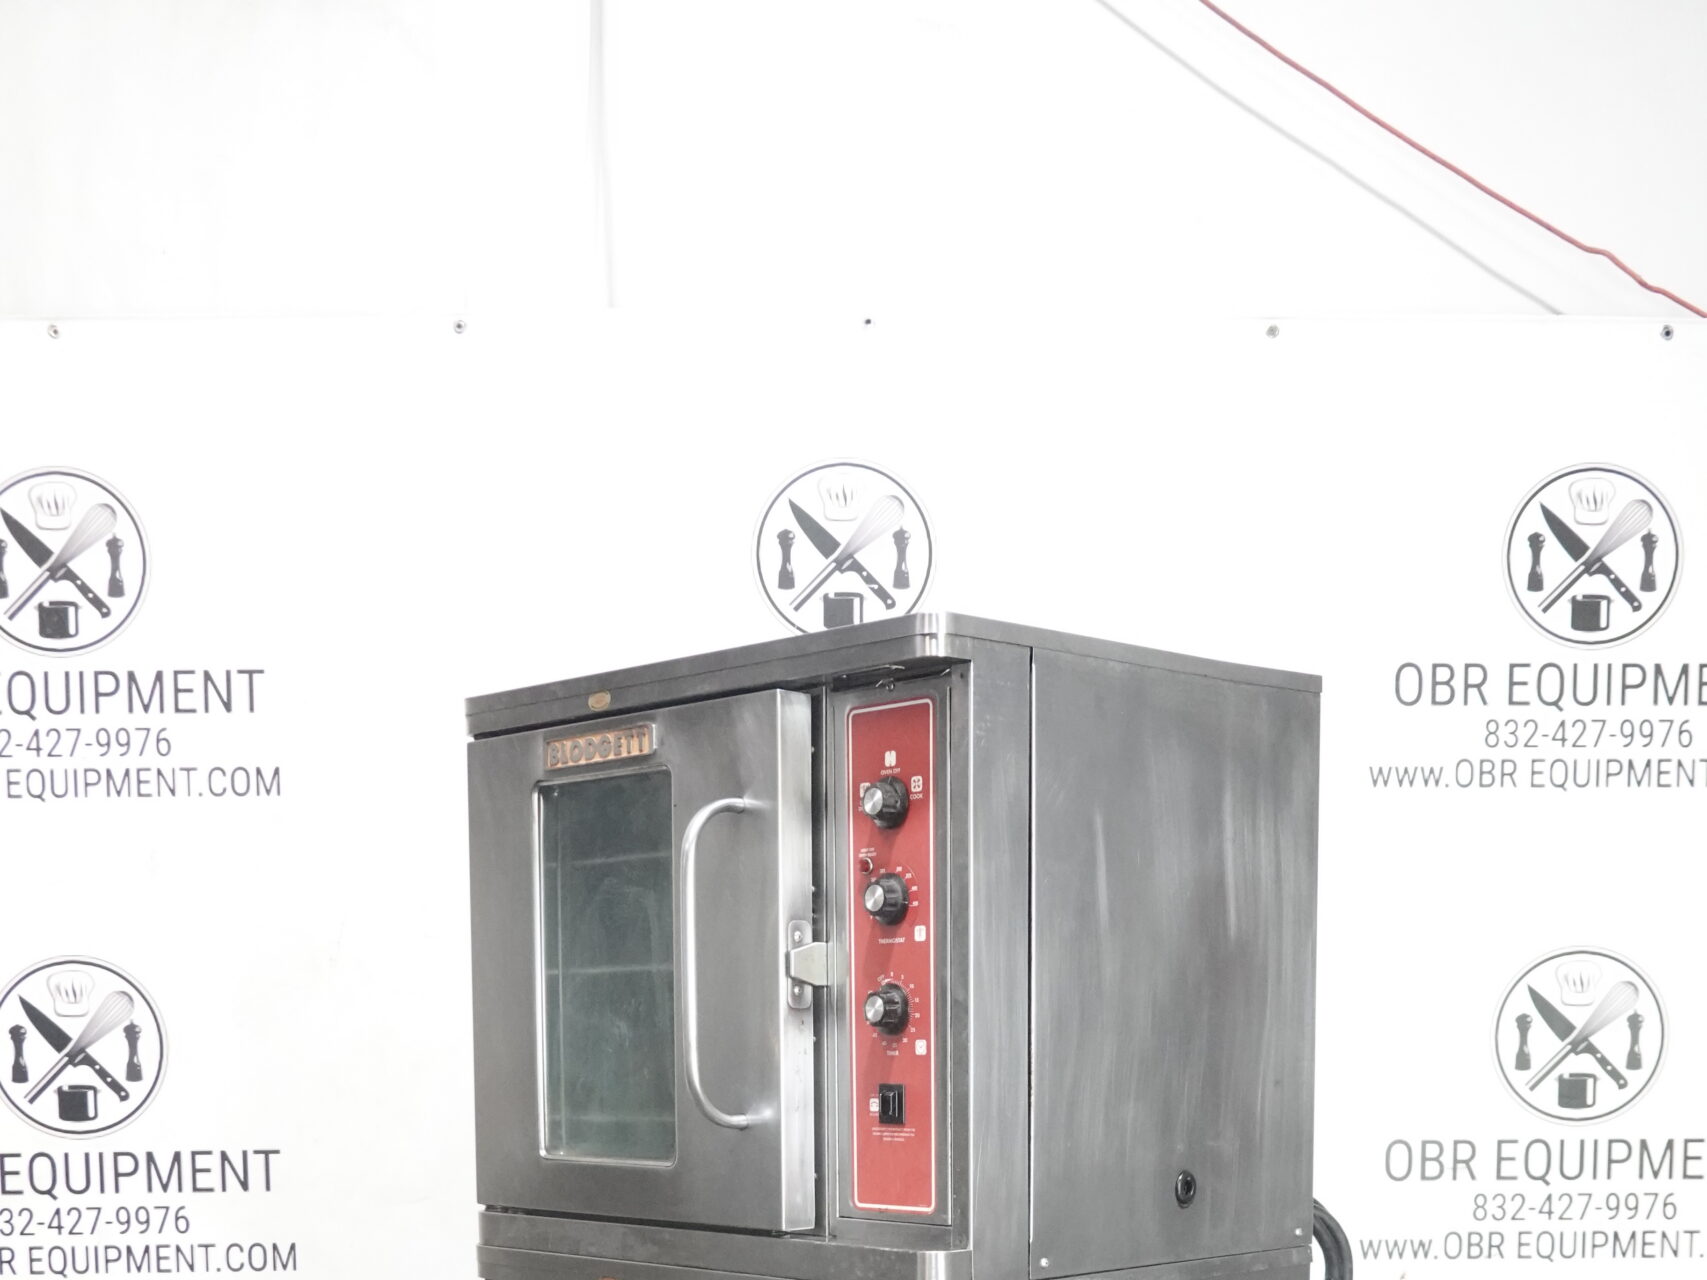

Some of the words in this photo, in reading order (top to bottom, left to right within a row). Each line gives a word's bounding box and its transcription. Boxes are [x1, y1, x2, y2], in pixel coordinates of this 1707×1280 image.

[0, 670, 264, 721] QUIPMENT
[1395, 663, 1488, 706] OBR
[549, 727, 646, 767] BLODGETT
[1485, 719, 1692, 748] 832-427-9976
[7, 767, 280, 802] EQUIPMENT.COM
[1370, 759, 1516, 788] www.OBR
[0, 1150, 280, 1201] EQUIPMENT
[1386, 1140, 1476, 1181] OBR
[1496, 1139, 1705, 1186] EQUIPME
[1473, 1193, 1676, 1221] 832-427-9976
[29, 1242, 296, 1278] EQUIPMENT.COM
[1360, 1232, 1504, 1259] www.OBR
